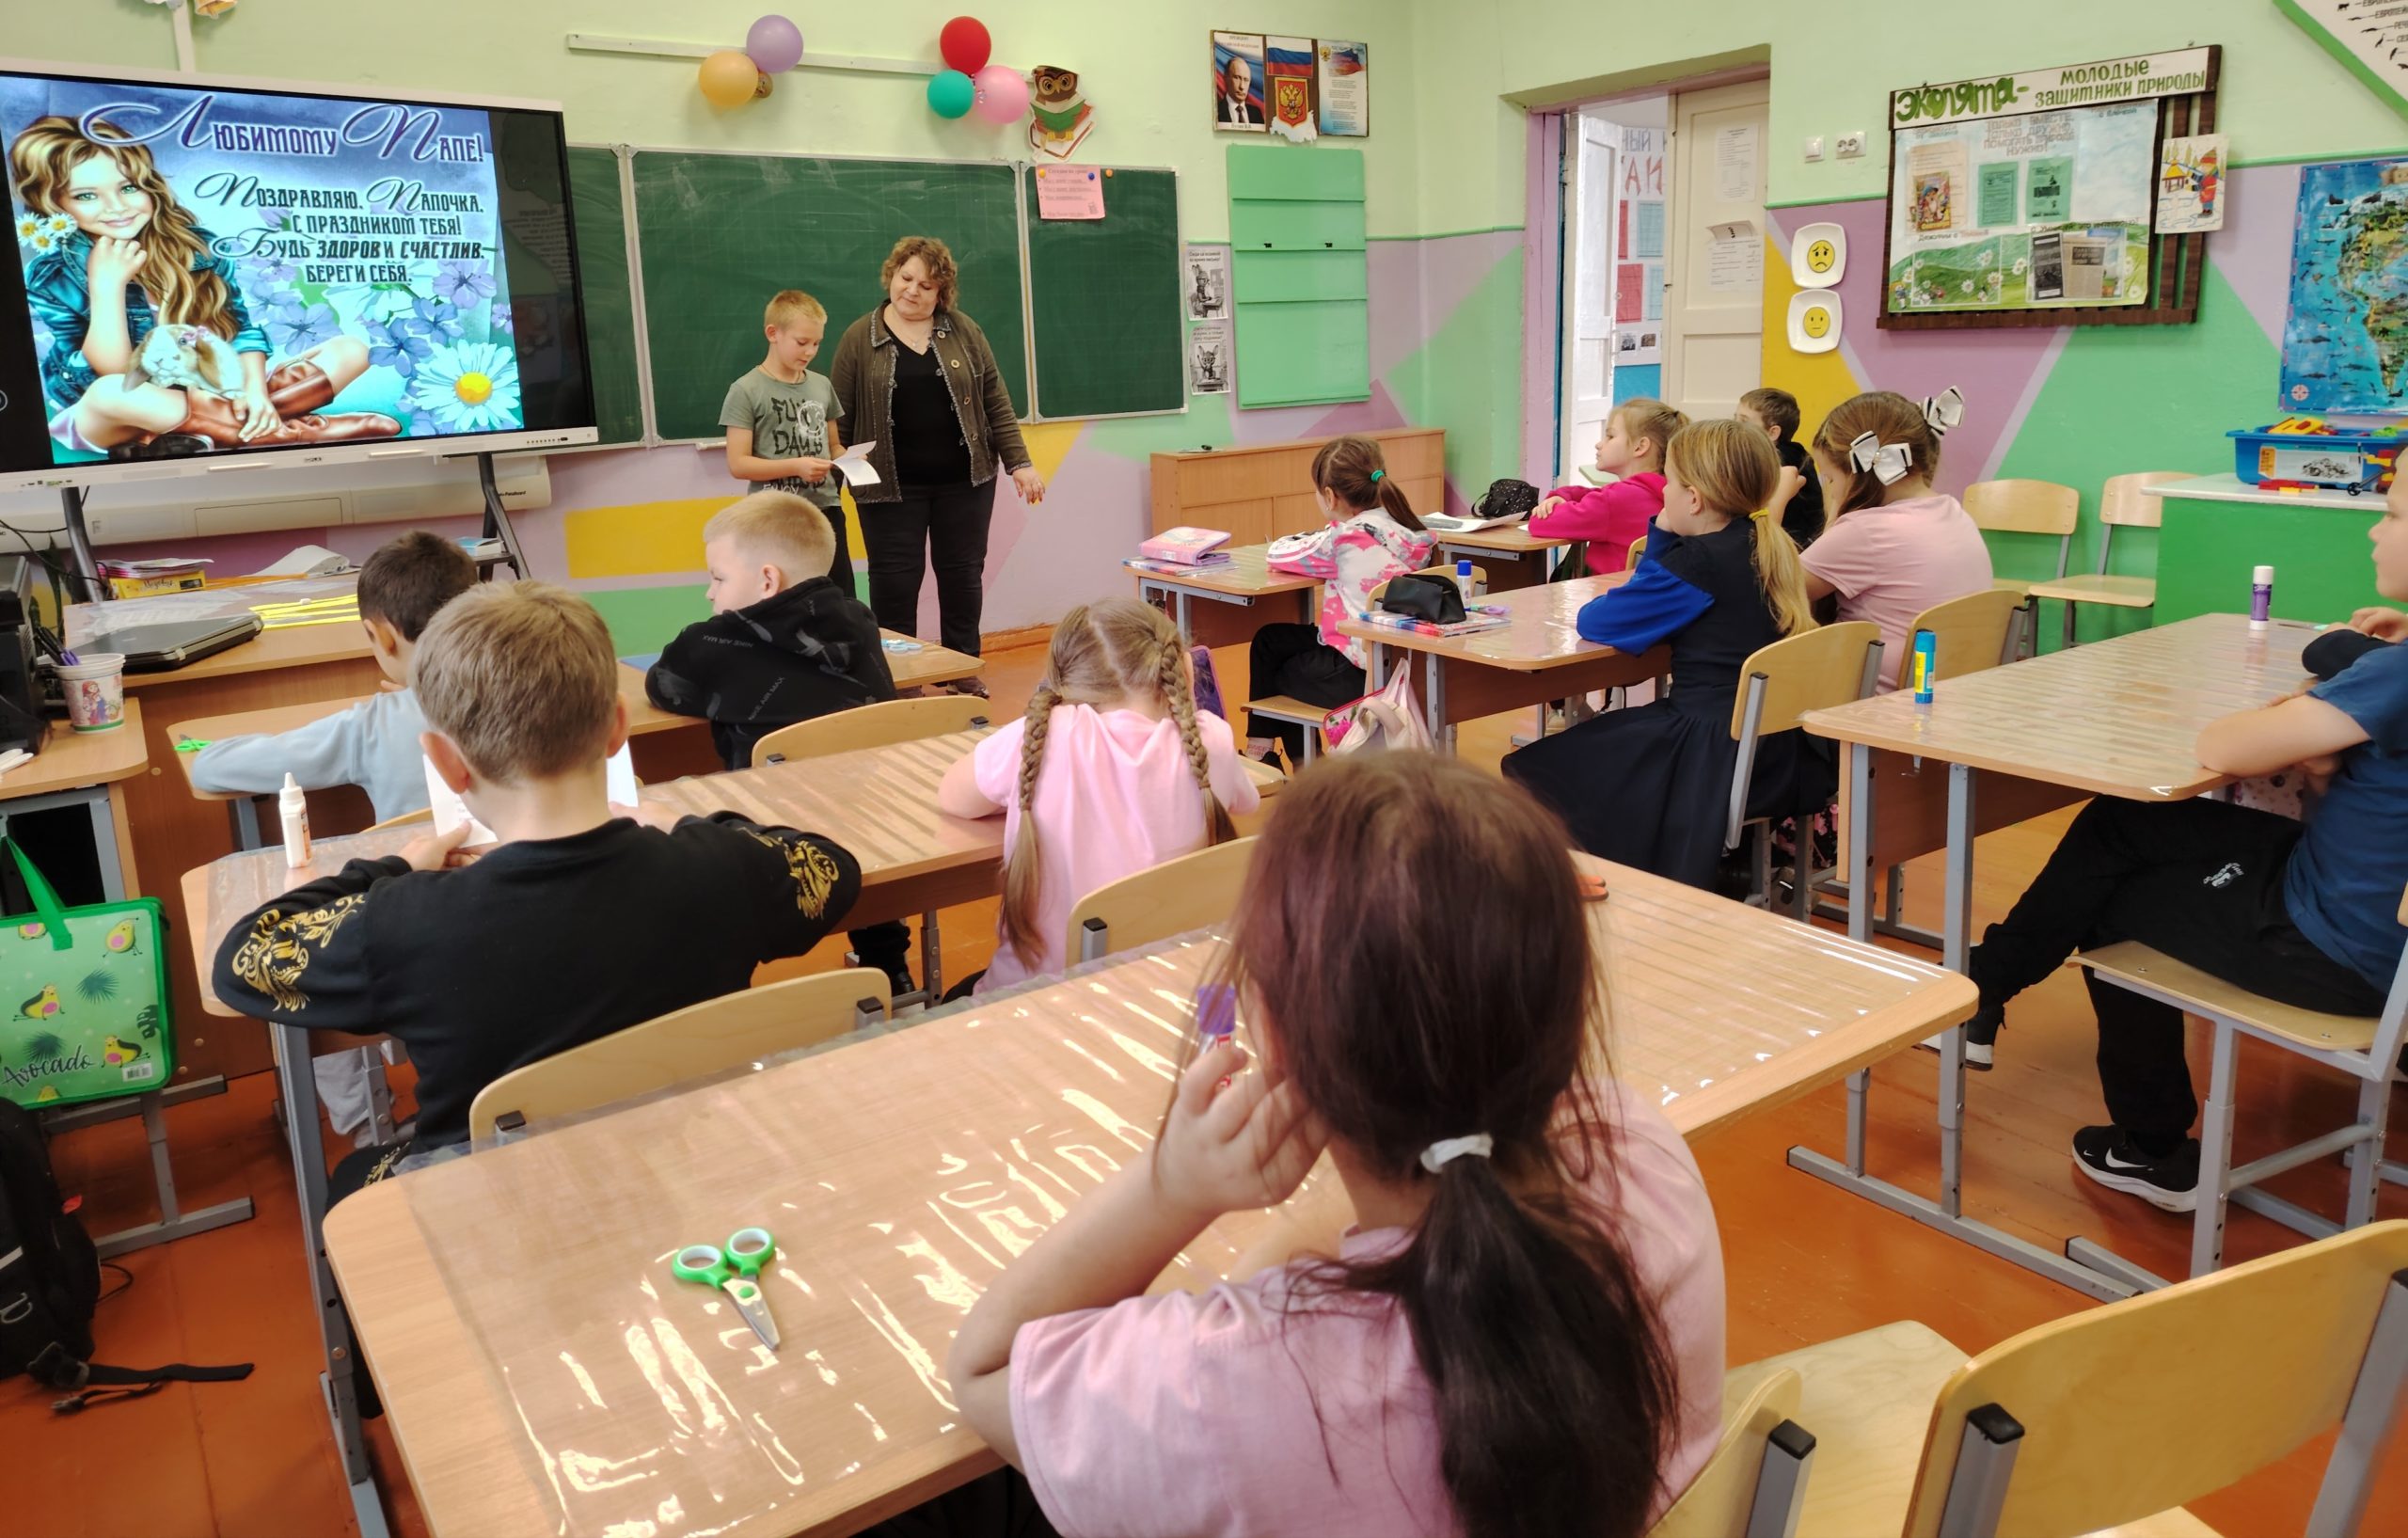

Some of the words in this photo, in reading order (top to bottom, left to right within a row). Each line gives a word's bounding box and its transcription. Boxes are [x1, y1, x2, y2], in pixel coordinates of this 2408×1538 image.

[2035, 80, 2132, 108] защитники
[2137, 70, 2206, 95] природы
[293, 214, 303, 234] С
[306, 214, 417, 235] ПРАЗДНИКОМ
[420, 214, 463, 236] ТЕБЯ!
[316, 239, 381, 260] ЗДОРОВ
[384, 240, 395, 259] И
[400, 240, 486, 260] СЧАСТЛИВ.
[306, 264, 366, 283] БЕРЕГИ
[369, 264, 414, 283] СЕБЯ.
[1, 1044, 95, 1087] Avocado
